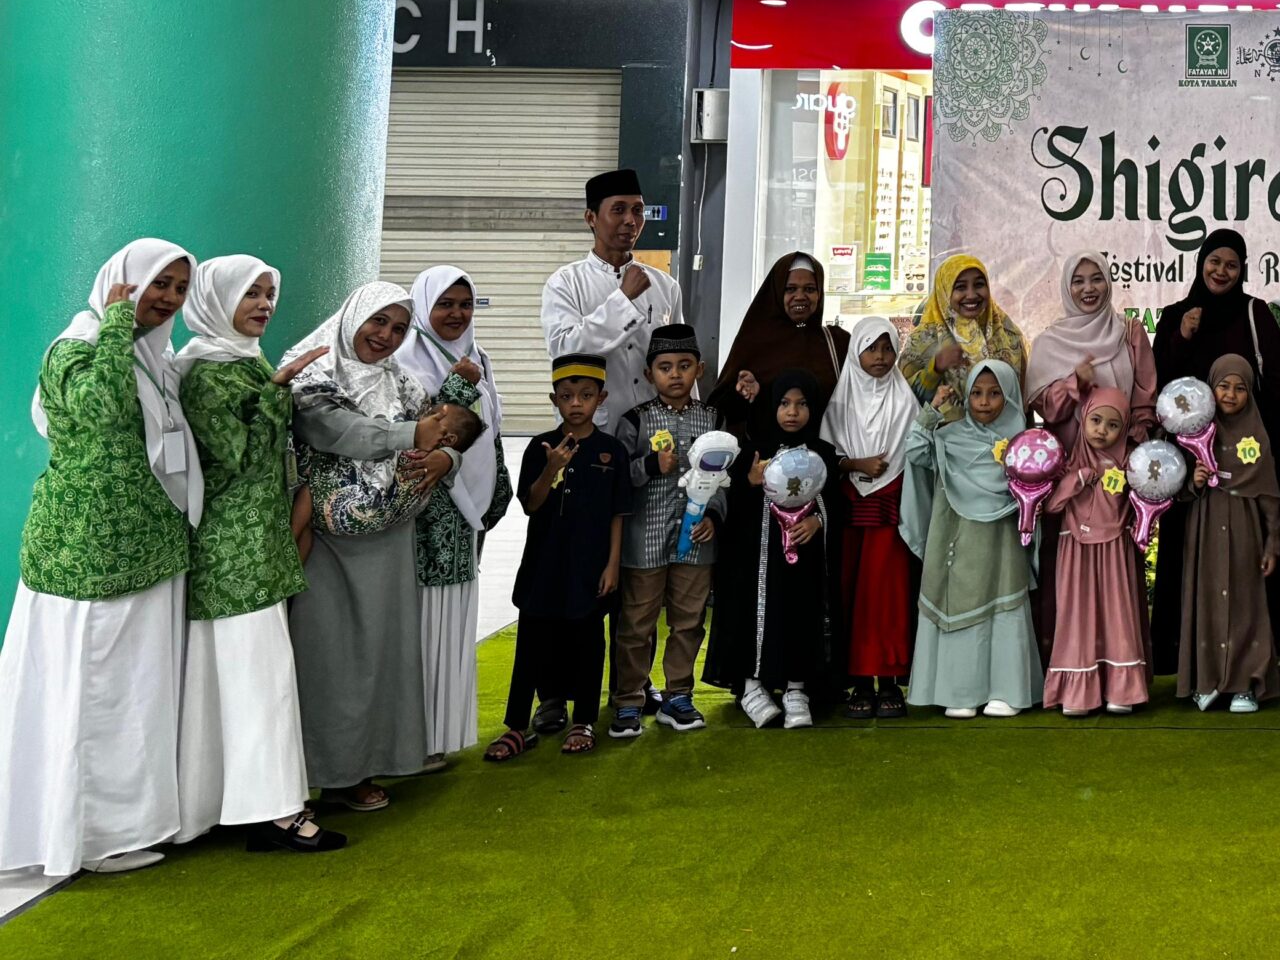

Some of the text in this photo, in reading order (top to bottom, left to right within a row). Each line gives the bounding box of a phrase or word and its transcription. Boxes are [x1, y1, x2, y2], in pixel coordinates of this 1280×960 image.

[1188, 68, 1229, 76] FATAYAT NU
[1178, 79, 1200, 88] KOTA
[1241, 447, 1257, 459] 10
[1101, 475, 1120, 490] 11
